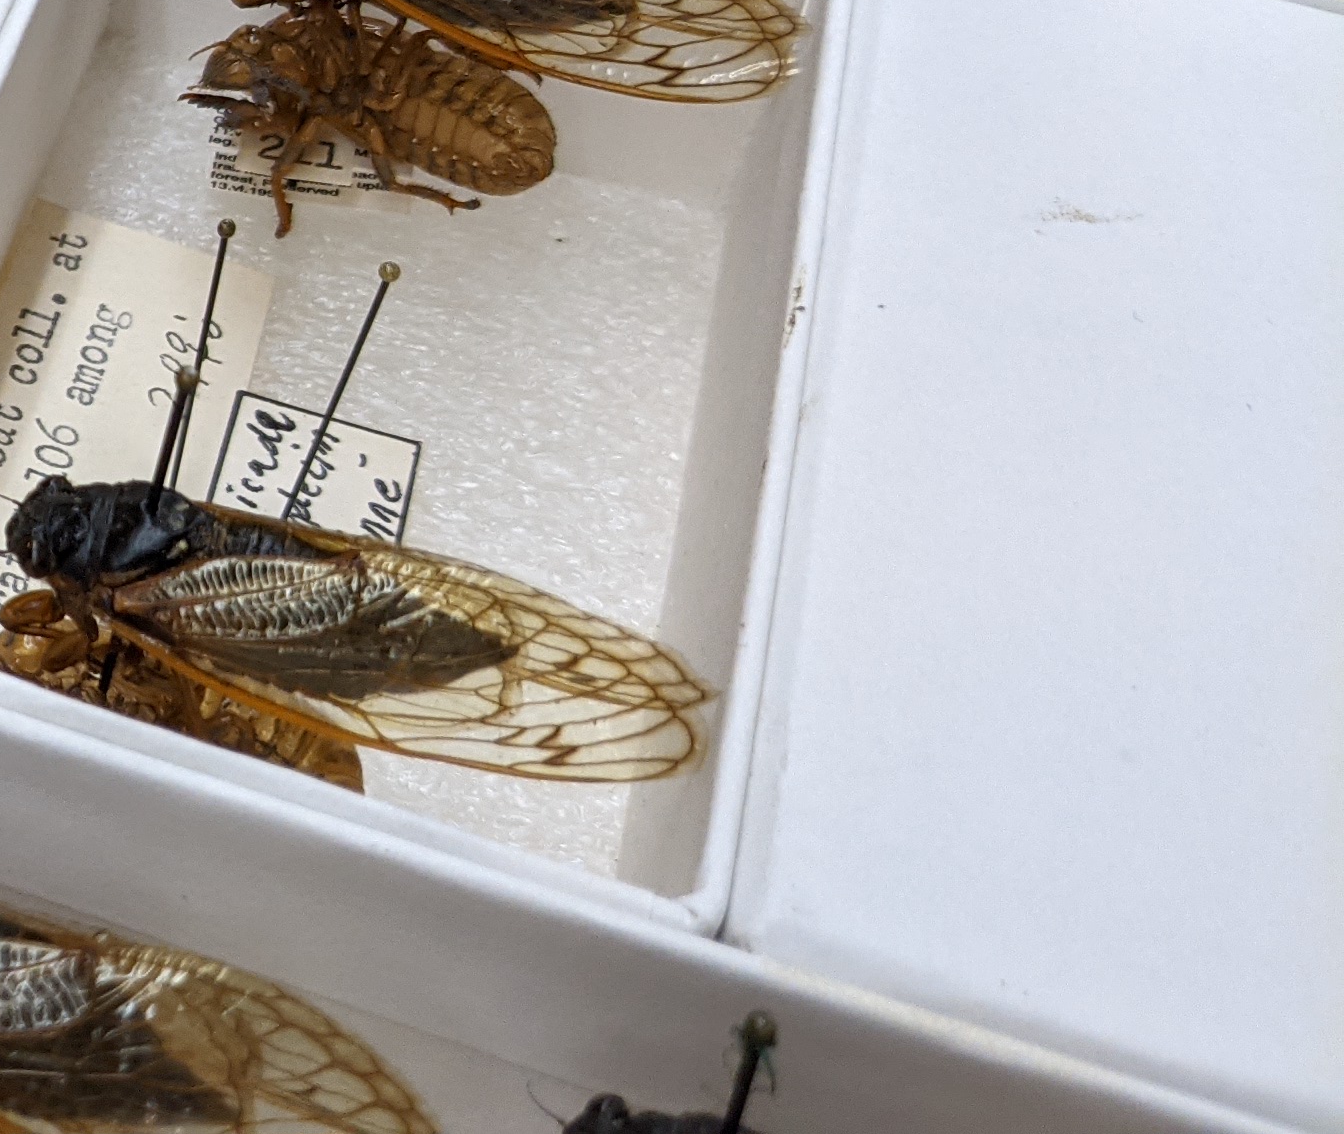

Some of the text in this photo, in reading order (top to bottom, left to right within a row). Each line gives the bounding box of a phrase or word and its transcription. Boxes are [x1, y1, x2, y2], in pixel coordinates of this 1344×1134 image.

[9, 293, 67, 386] coll.
[49, 232, 88, 272] at
[66, 303, 133, 407] among
